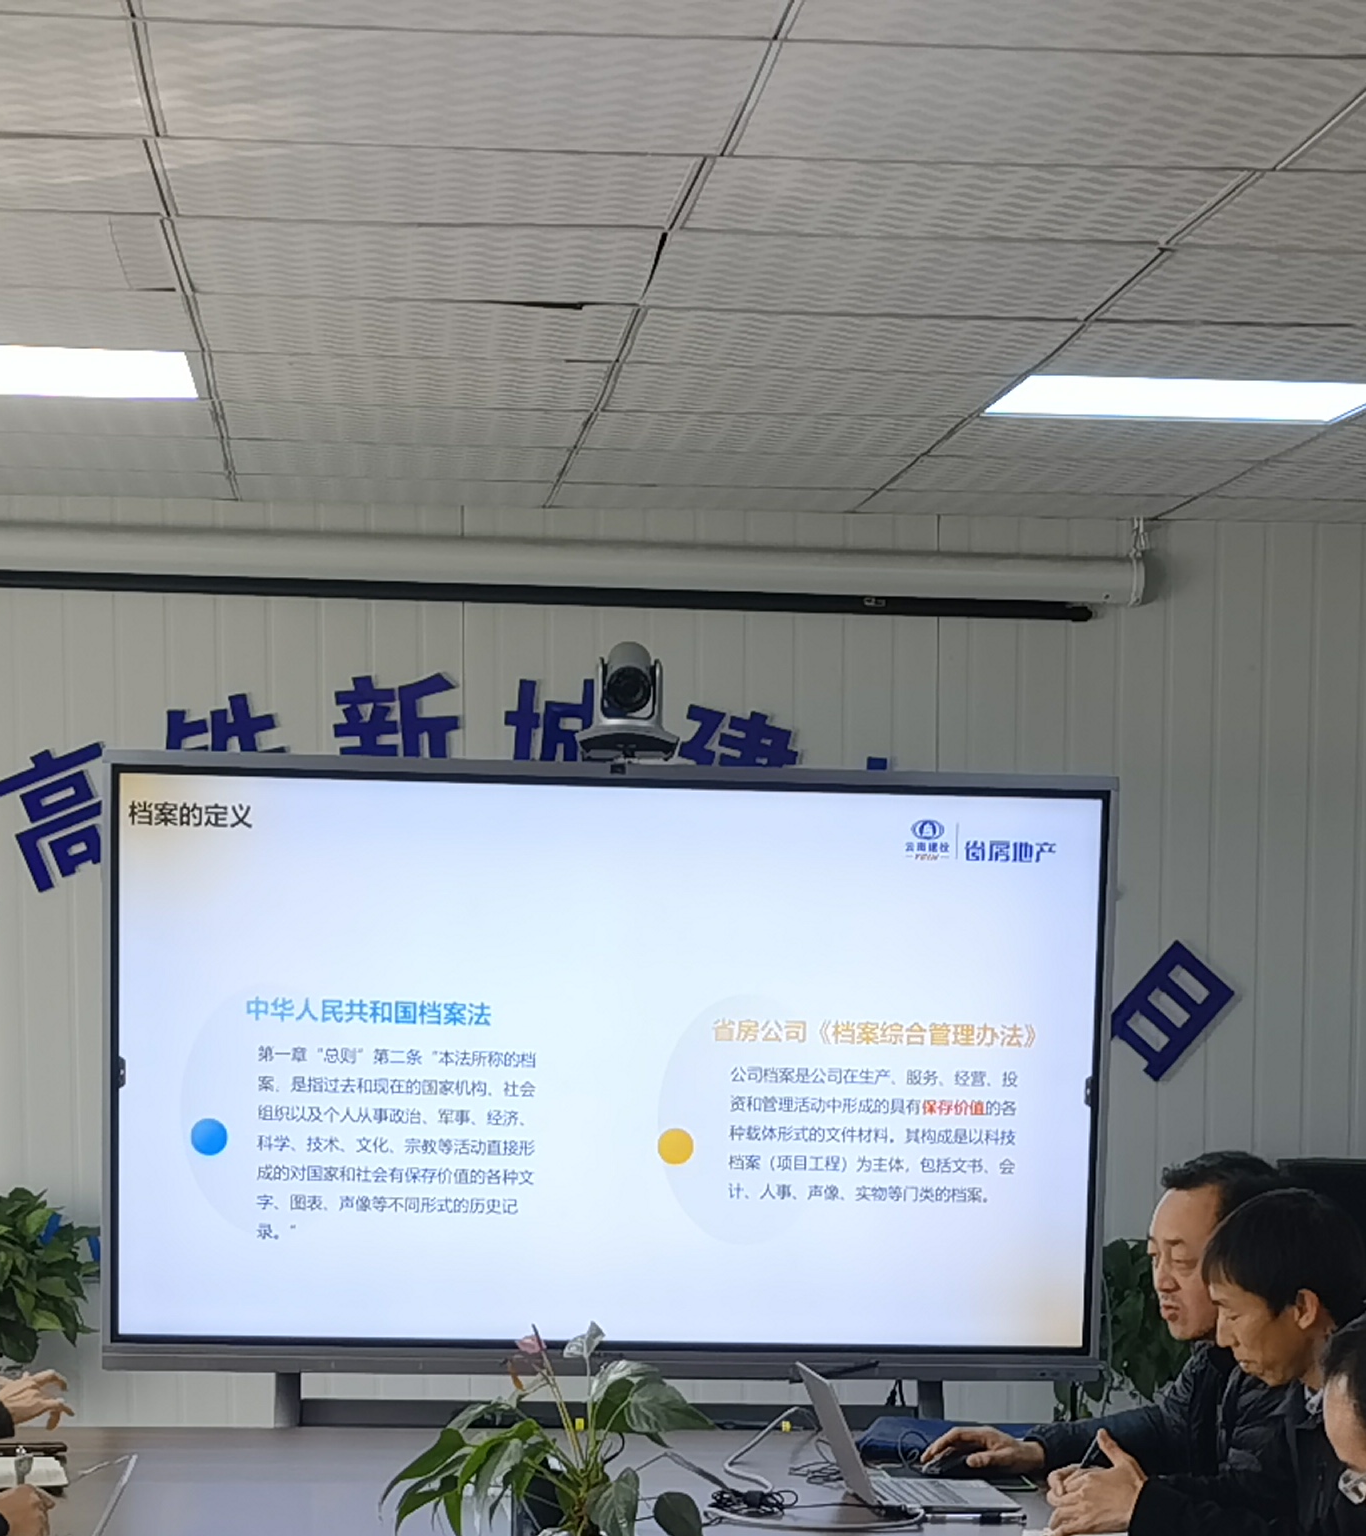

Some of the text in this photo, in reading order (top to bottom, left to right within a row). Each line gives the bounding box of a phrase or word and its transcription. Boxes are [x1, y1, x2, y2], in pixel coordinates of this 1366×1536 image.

[128, 801, 253, 829] 档案的定义
[964, 840, 1057, 863] 省房地产
[245, 997, 492, 1027] 中华人民共和国档案法
[713, 1019, 1037, 1048] 省房公司《档案综合管理办法》
[730, 1066, 1019, 1088] 公司档案是公司在生产、服务、经营、投
[257, 1104, 525, 1127] 组织以及个人从事政治、军事、经济、
[730, 1095, 1017, 1117] 资和管理活动中形成的具有保存价值的各
[256, 1134, 536, 1156] 科学、技术、文化、宗教等活动直接形
[256, 1164, 535, 1186] 成的对国家和社会有保存价值的各种文
[256, 1194, 519, 1215] 字、图表、声像等不同形式的历史记
